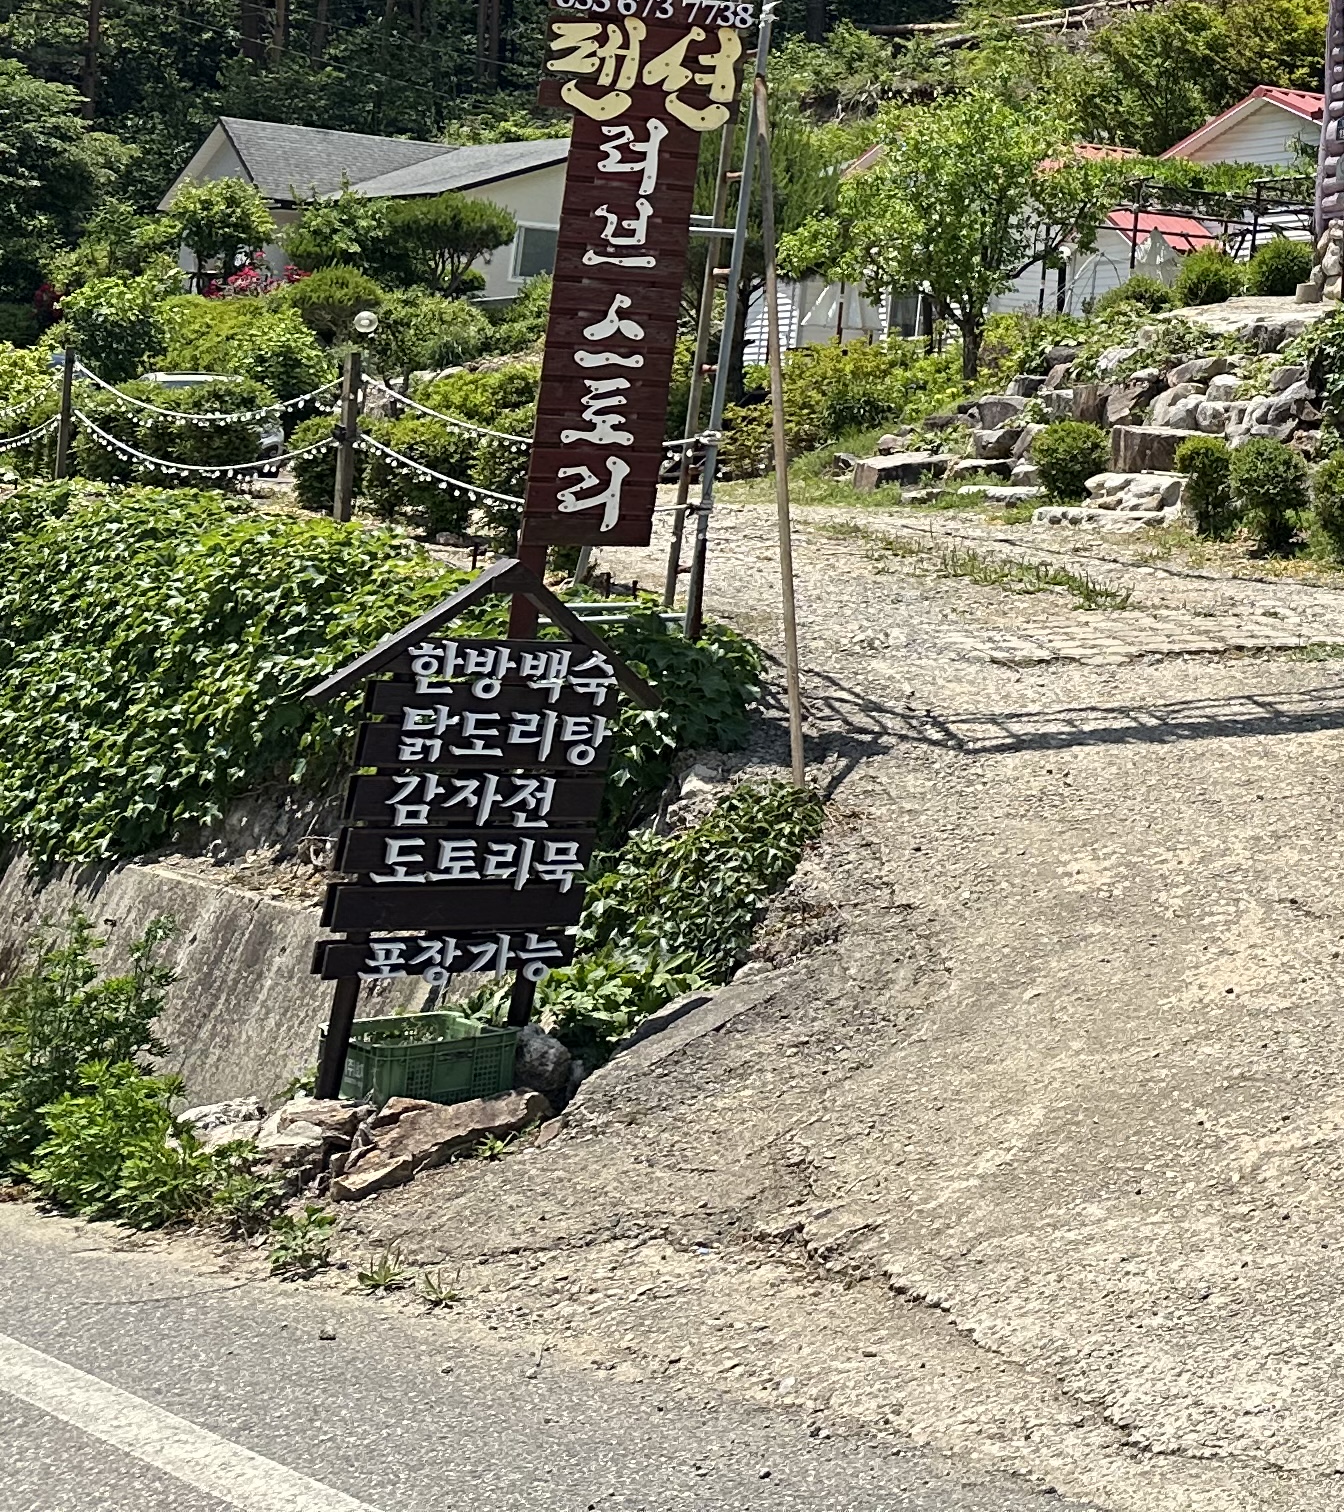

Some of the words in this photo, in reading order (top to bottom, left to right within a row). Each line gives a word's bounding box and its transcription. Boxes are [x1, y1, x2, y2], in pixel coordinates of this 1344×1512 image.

[556, 117, 669, 532] 러브스토리
[407, 640, 619, 707] 한방백숙
[398, 704, 613, 766] 닭도리탕
[384, 772, 557, 828] 감자전
[369, 837, 585, 894] 도토리묵
[356, 932, 564, 986] 포장가능
